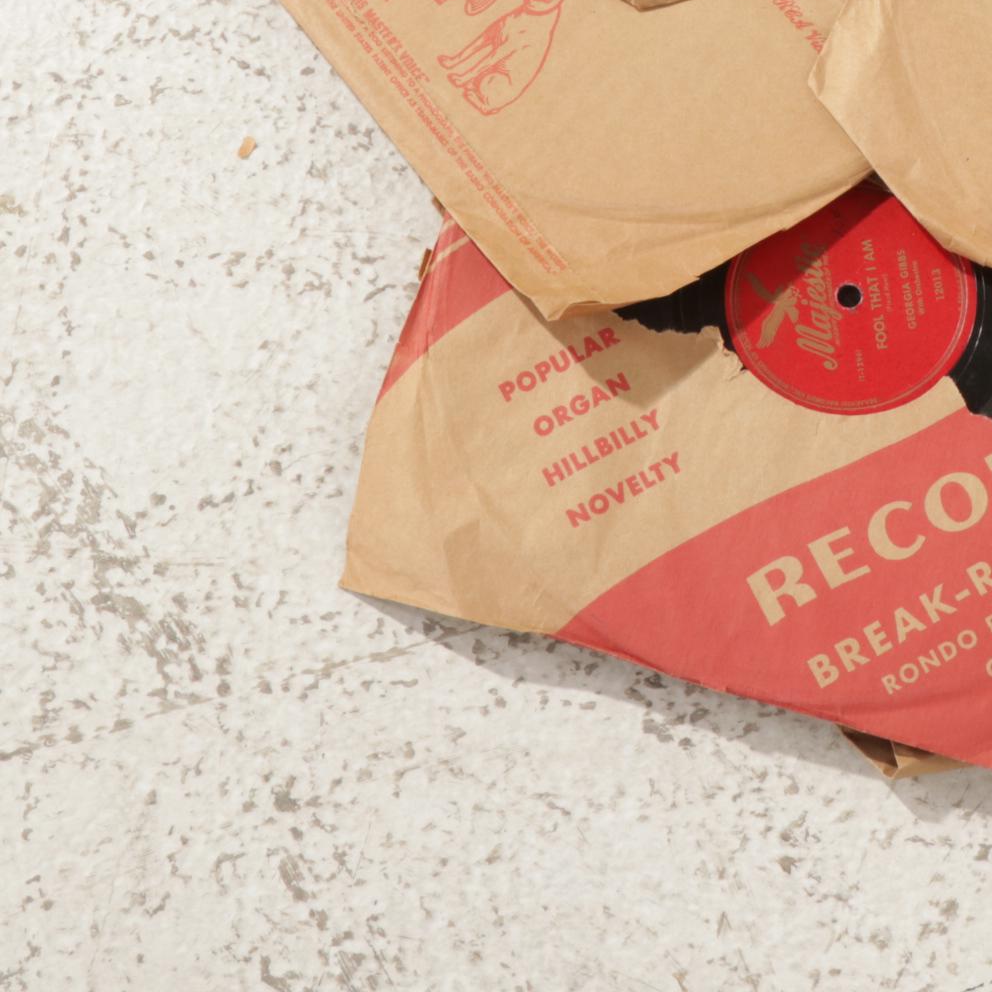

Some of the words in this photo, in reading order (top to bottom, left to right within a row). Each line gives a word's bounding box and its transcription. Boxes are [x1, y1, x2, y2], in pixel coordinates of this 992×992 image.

[862, 239, 875, 261] AM
[897, 249, 909, 279] GIBBS
[794, 244, 843, 371] Majestic
[866, 273, 882, 311] THAT
[901, 281, 917, 330] GEORGIA
[498, 327, 621, 402] POPULAR
[873, 314, 888, 351] FOOL
[533, 372, 631, 437] ORGAN
[541, 408, 660, 487] HILLBILLY
[565, 451, 681, 528] NOVELTY
[881, 629, 979, 695] RONDO
